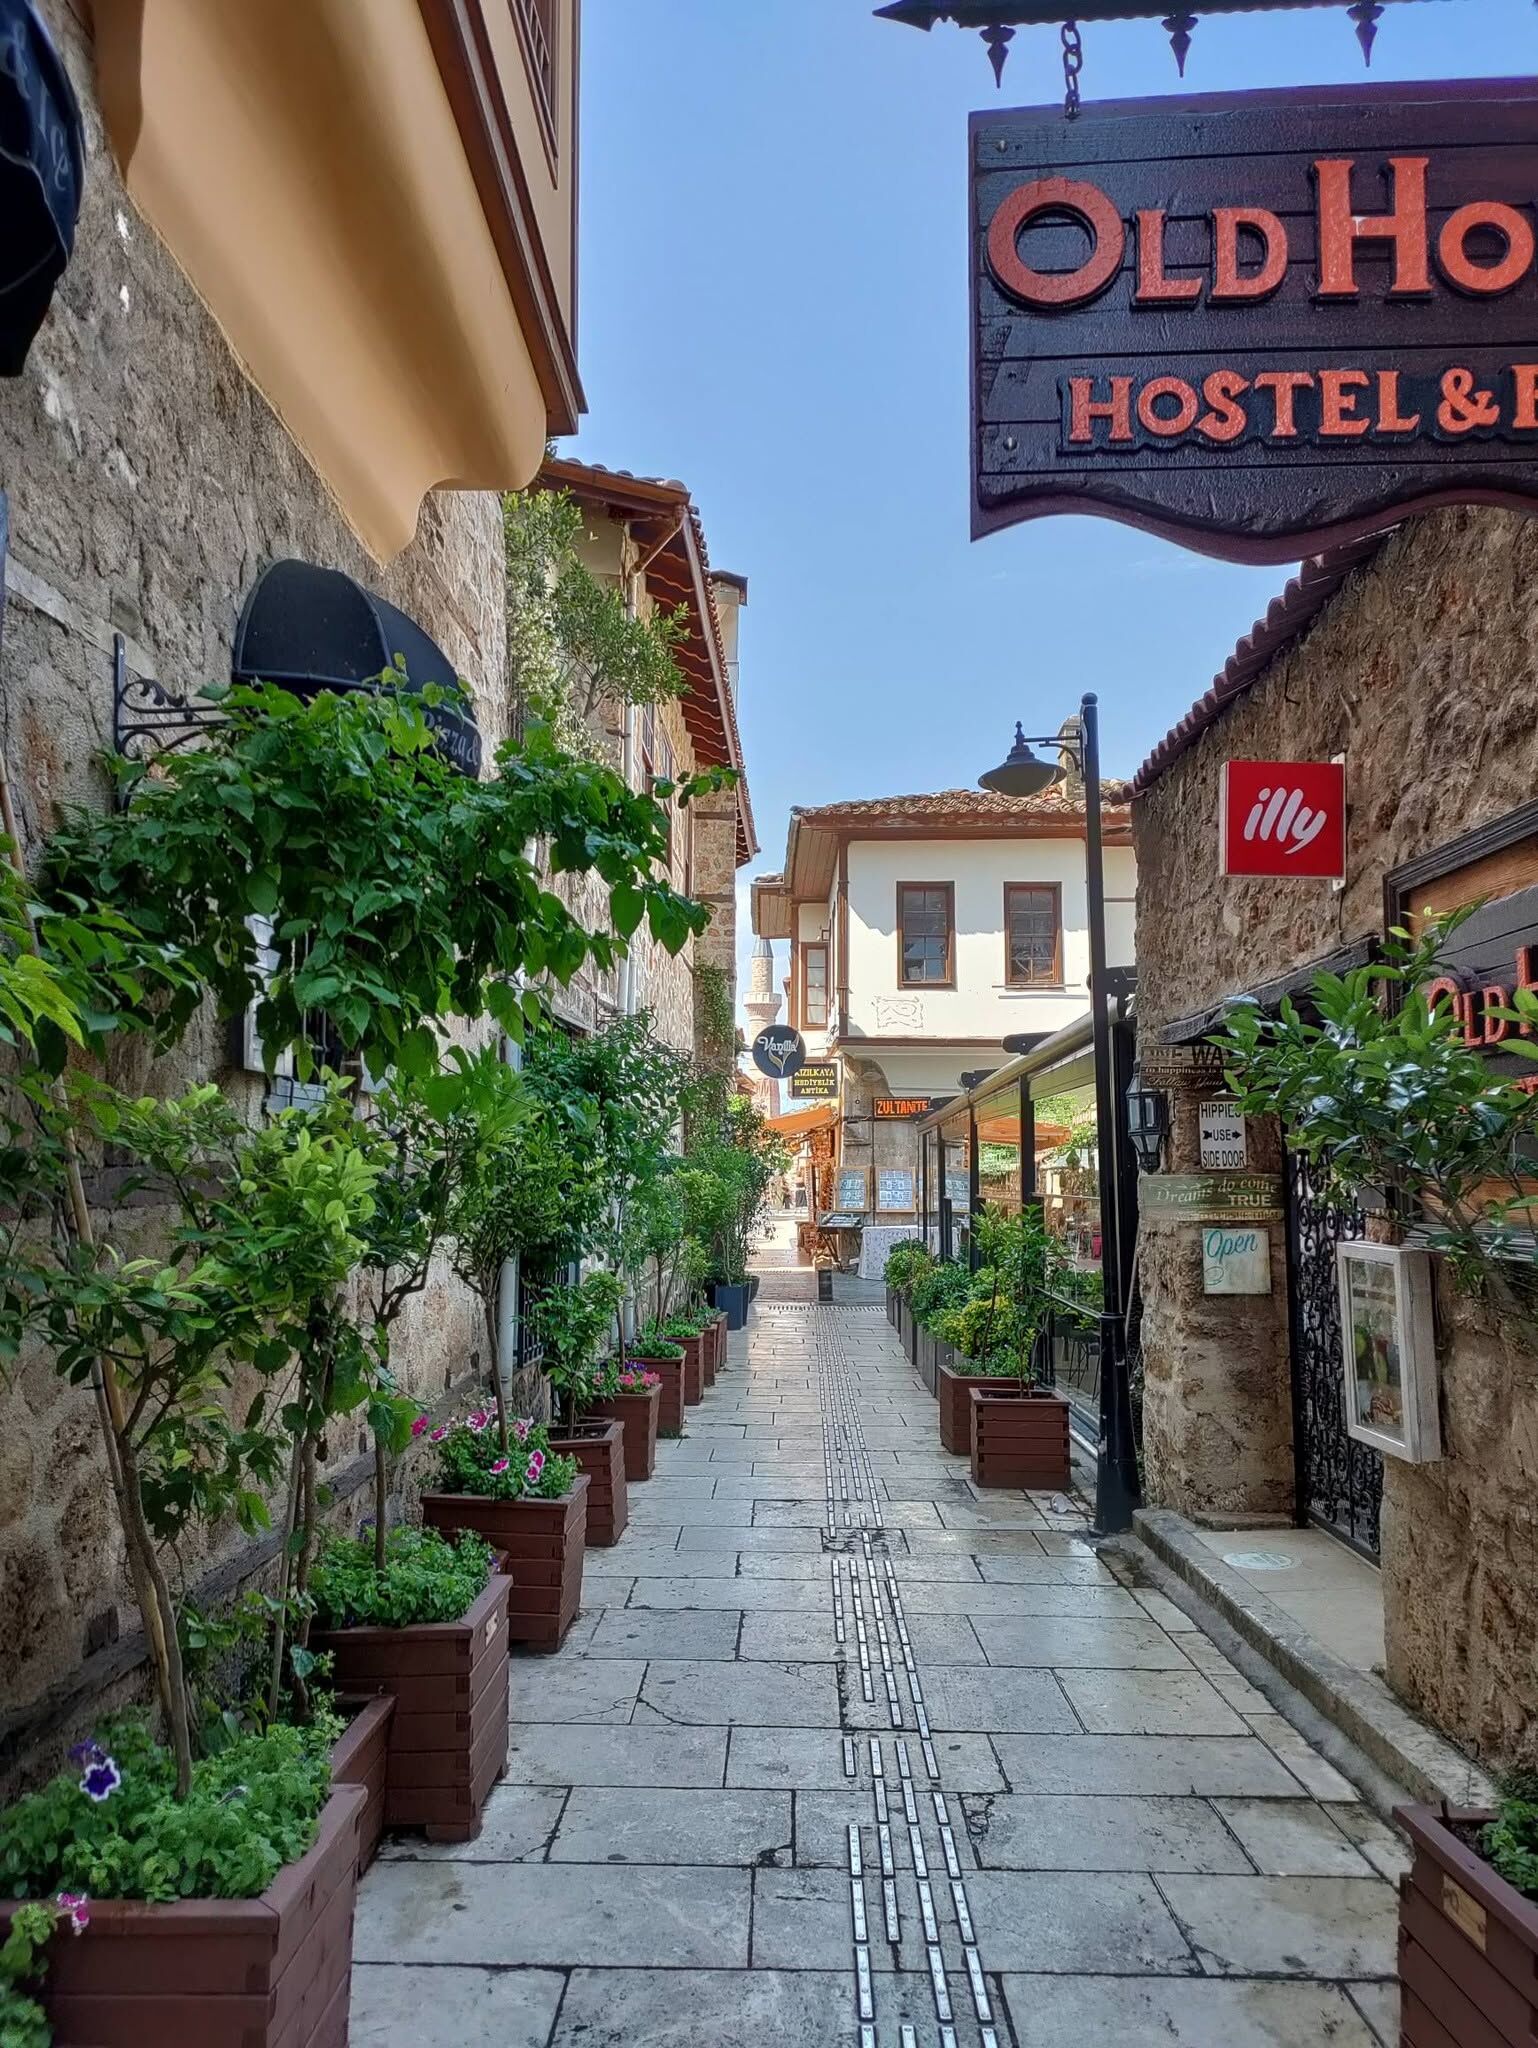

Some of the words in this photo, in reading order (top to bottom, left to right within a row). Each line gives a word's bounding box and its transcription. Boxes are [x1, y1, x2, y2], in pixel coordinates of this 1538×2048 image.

[987, 176, 1288, 305] OLD
[1068, 369, 1420, 443] HOSTEL
[1437, 367, 1501, 434] &
[1244, 787, 1328, 855] illy
[757, 1036, 798, 1055] Vanilla
[1192, 1045, 1232, 1065] WA
[1158, 1066, 1206, 1075] happiness
[800, 1086, 829, 1094] ANTİKA
[1212, 1129, 1232, 1141] USE
[1202, 1150, 1220, 1167] SIDE
[1222, 1150, 1246, 1167] DOOR
[1155, 1185, 1214, 1203] Dreams
[1218, 1176, 1236, 1192] do
[1240, 1177, 1277, 1194] come
[1228, 1194, 1272, 1206] TRUE
[1206, 1230, 1258, 1265] Open
